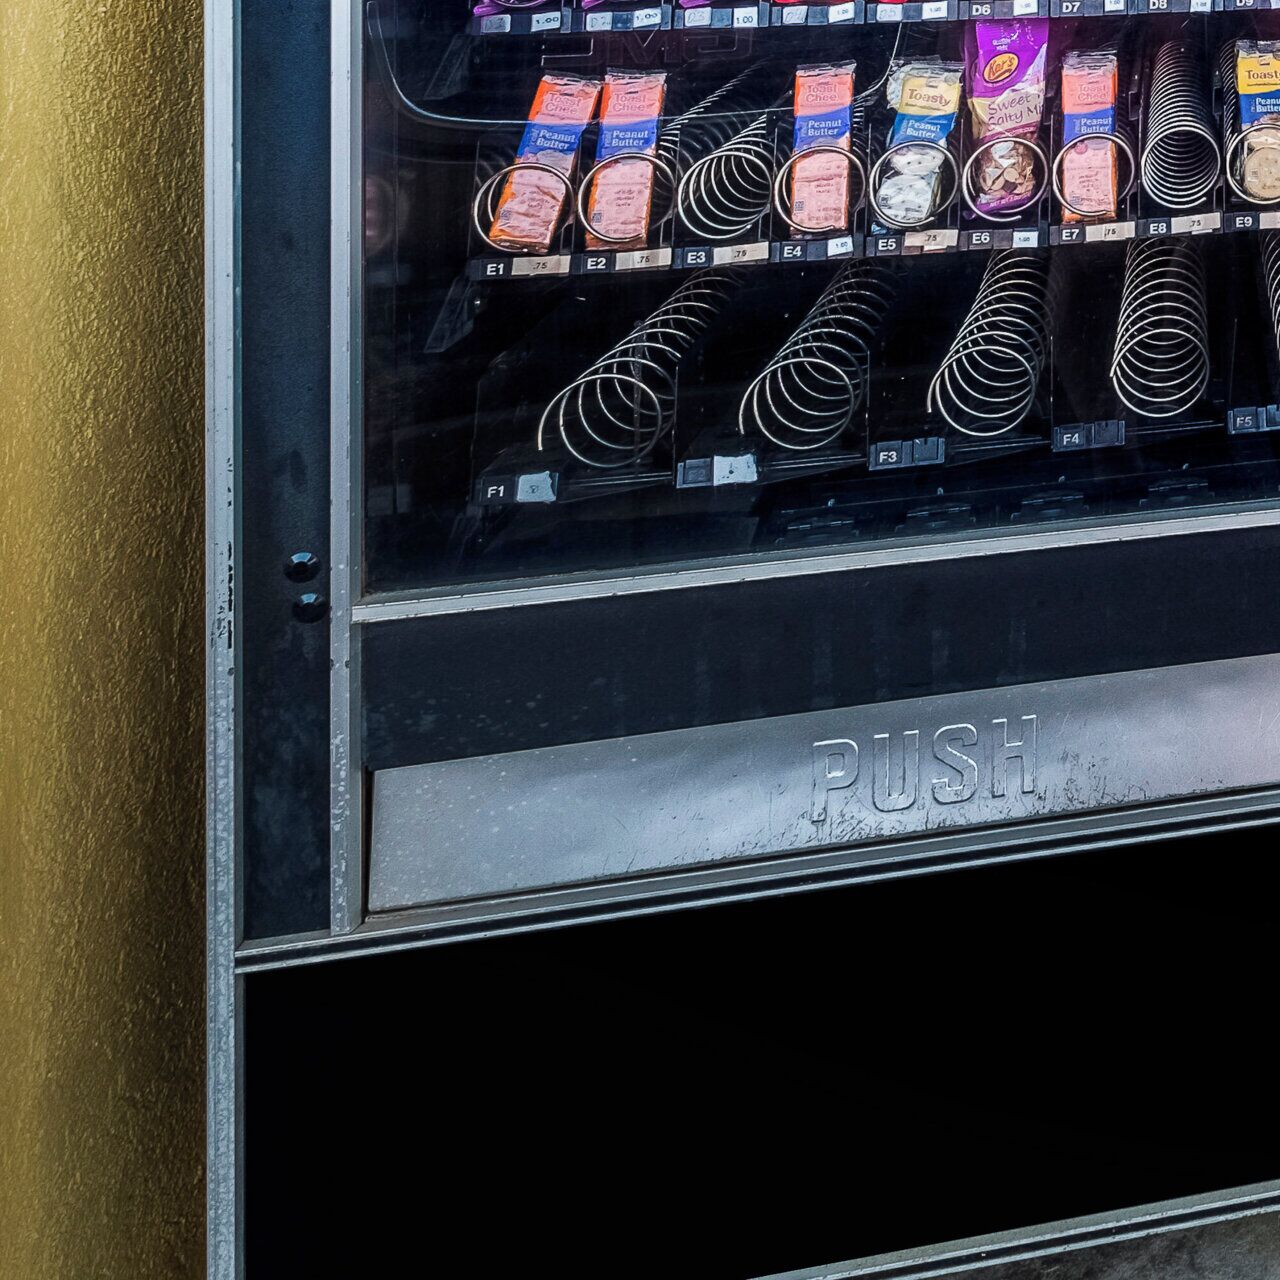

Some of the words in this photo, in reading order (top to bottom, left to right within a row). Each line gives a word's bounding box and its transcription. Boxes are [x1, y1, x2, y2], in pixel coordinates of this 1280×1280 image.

[971, 4, 991, 16] D6
[1062, 2, 1081, 13] D7
[1150, 0, 1168, 10] D8
[535, 16, 559, 25] 1.00
[635, 11, 660, 22] 1.00
[736, 15, 754, 25] 1.00
[806, 83, 839, 95] Toast
[907, 88, 951, 106] Toasty
[987, 96, 1032, 116] Sweet
[807, 119, 842, 129] Peanut
[986, 109, 1024, 131] Salty
[1027, 105, 1045, 119] Mi
[1080, 117, 1113, 127] Peanut
[807, 127, 840, 137] Butter
[908, 119, 942, 133] Peanut
[1080, 125, 1110, 134] Butter
[538, 129, 577, 143] Peanut
[612, 130, 649, 140] Peanut
[906, 127, 938, 140] Butter
[536, 138, 571, 151] Butter
[611, 138, 644, 148] Butter
[1149, 222, 1168, 234] E8
[1235, 216, 1254, 228] E9
[972, 232, 991, 244] E6
[1061, 228, 1080, 241] E7
[878, 238, 897, 251] E5
[687, 252, 707, 264] E3
[783, 246, 803, 258] E4
[486, 263, 505, 275] E1
[531, 262, 548, 270] .75
[586, 257, 607, 270] E2
[636, 255, 651, 264] .75
[1235, 416, 1253, 428] F5
[1062, 434, 1080, 446] F4
[878, 451, 898, 464] F3
[487, 485, 505, 499] F1
[810, 715, 1038, 825] PUSH
